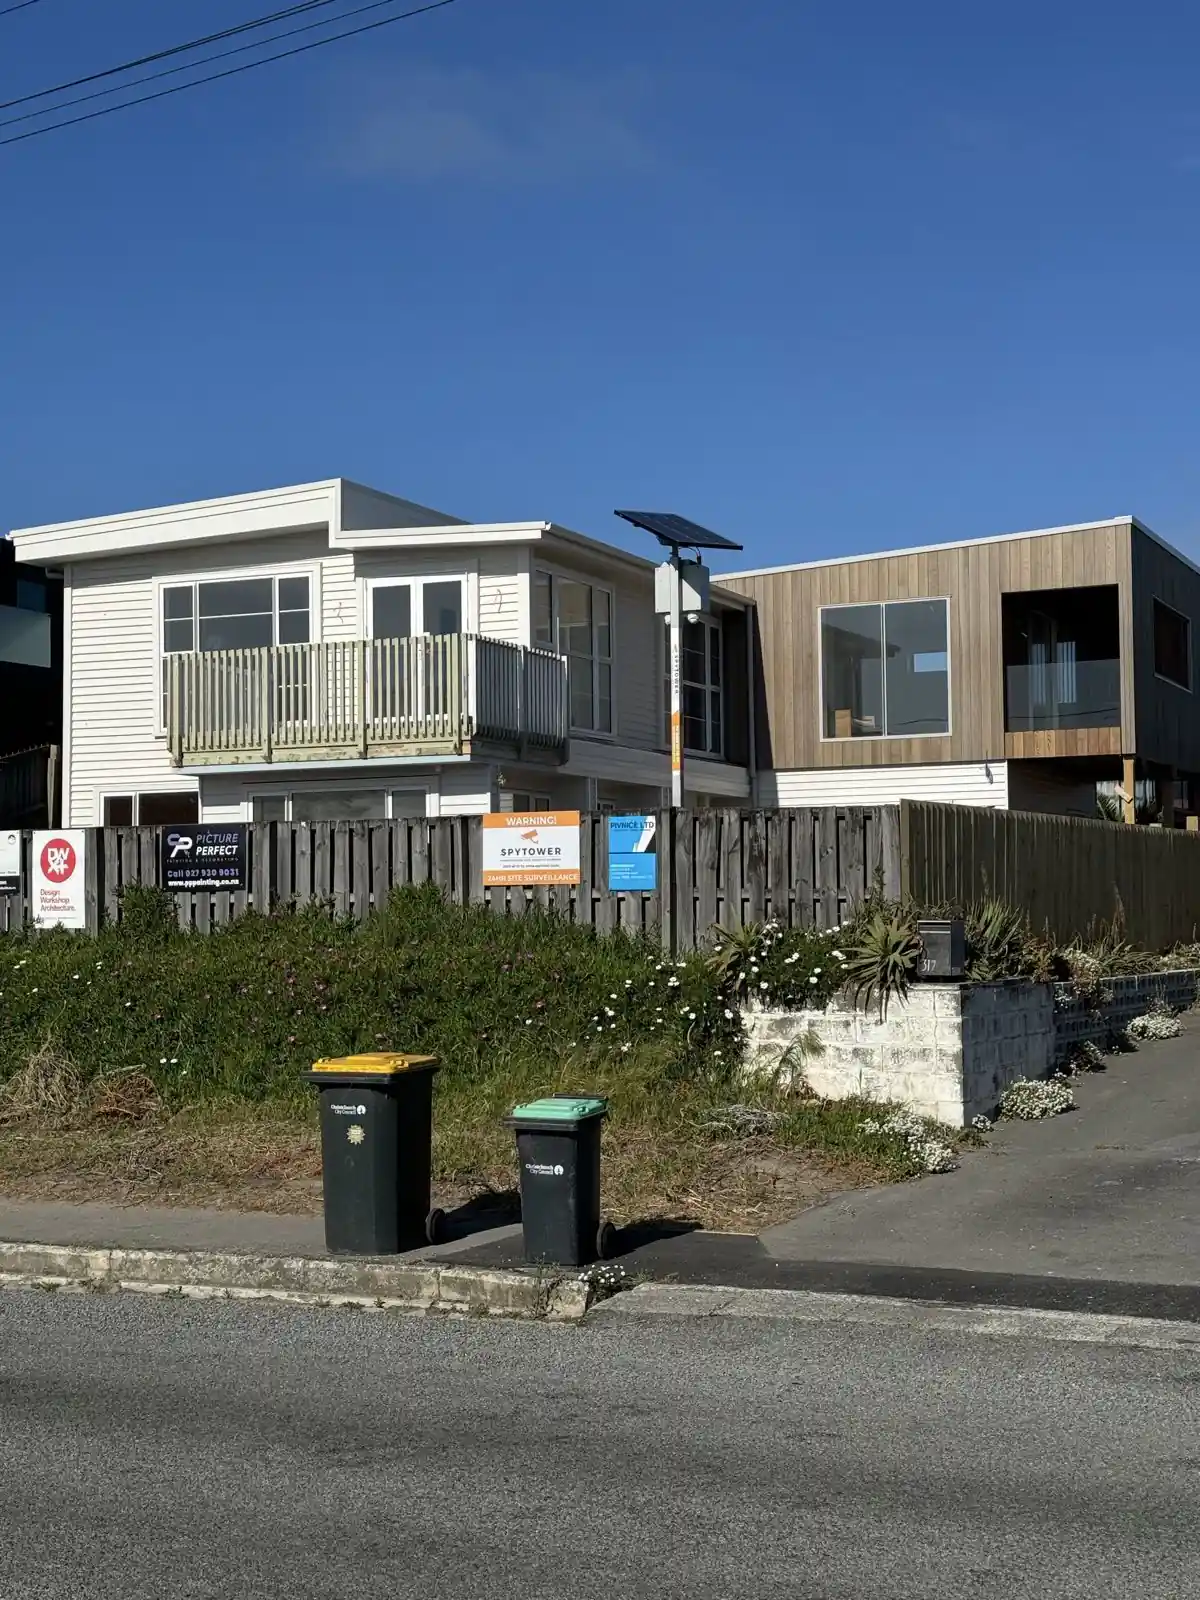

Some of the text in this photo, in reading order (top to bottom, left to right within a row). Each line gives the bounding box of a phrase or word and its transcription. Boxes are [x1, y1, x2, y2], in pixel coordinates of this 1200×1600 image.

[505, 816, 557, 826] WARNING!
[640, 821, 654, 829] LTD
[196, 833, 239, 844] PICTURE
[195, 845, 239, 856] PERFECT
[500, 847, 562, 857] SPYTOWER
[167, 869, 184, 878] Call
[507, 874, 522, 882] SITE
[523, 873, 578, 881] SURVEILLANCE
[40, 888, 60, 897] Design
[40, 896, 70, 905] Workshop
